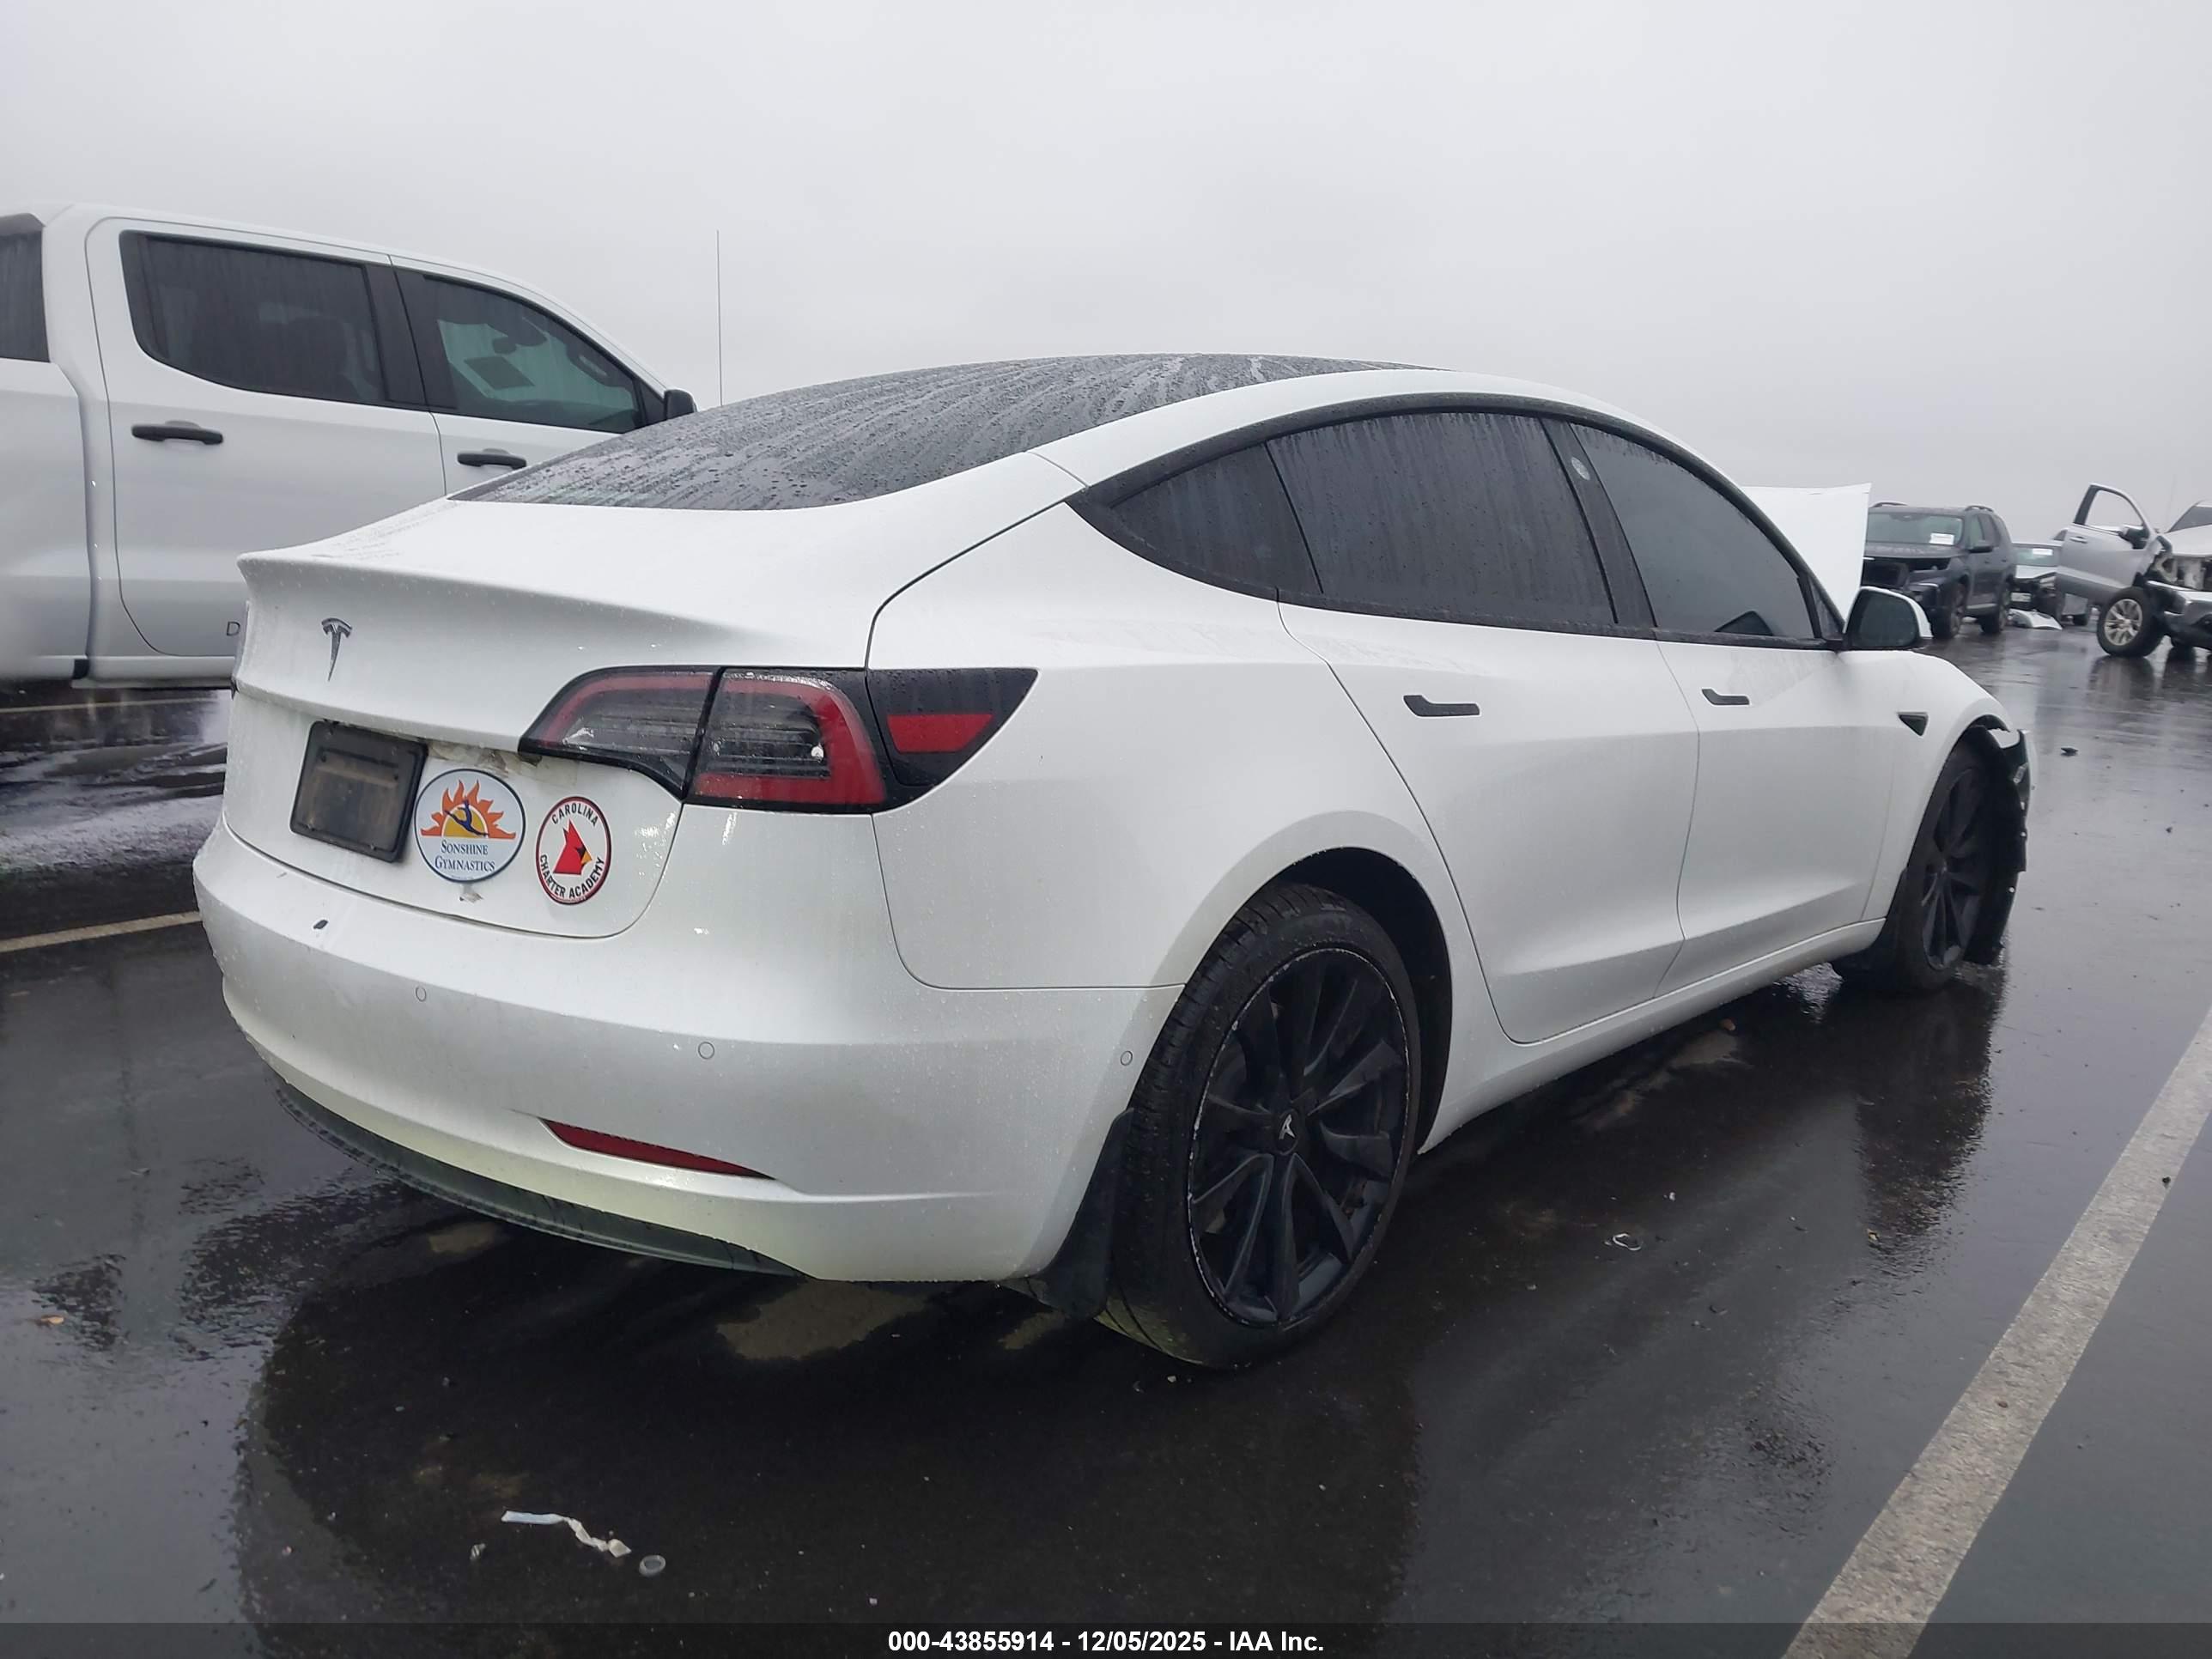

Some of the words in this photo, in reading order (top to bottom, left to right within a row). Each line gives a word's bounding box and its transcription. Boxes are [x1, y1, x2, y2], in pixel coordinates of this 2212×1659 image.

[552, 802, 599, 827] CAROLINA
[441, 839, 489, 855] SONSHINE
[434, 855, 495, 872] GYMNASTICS
[539, 854, 566, 898] CHARTER
[569, 857, 605, 899] ACADEMY
